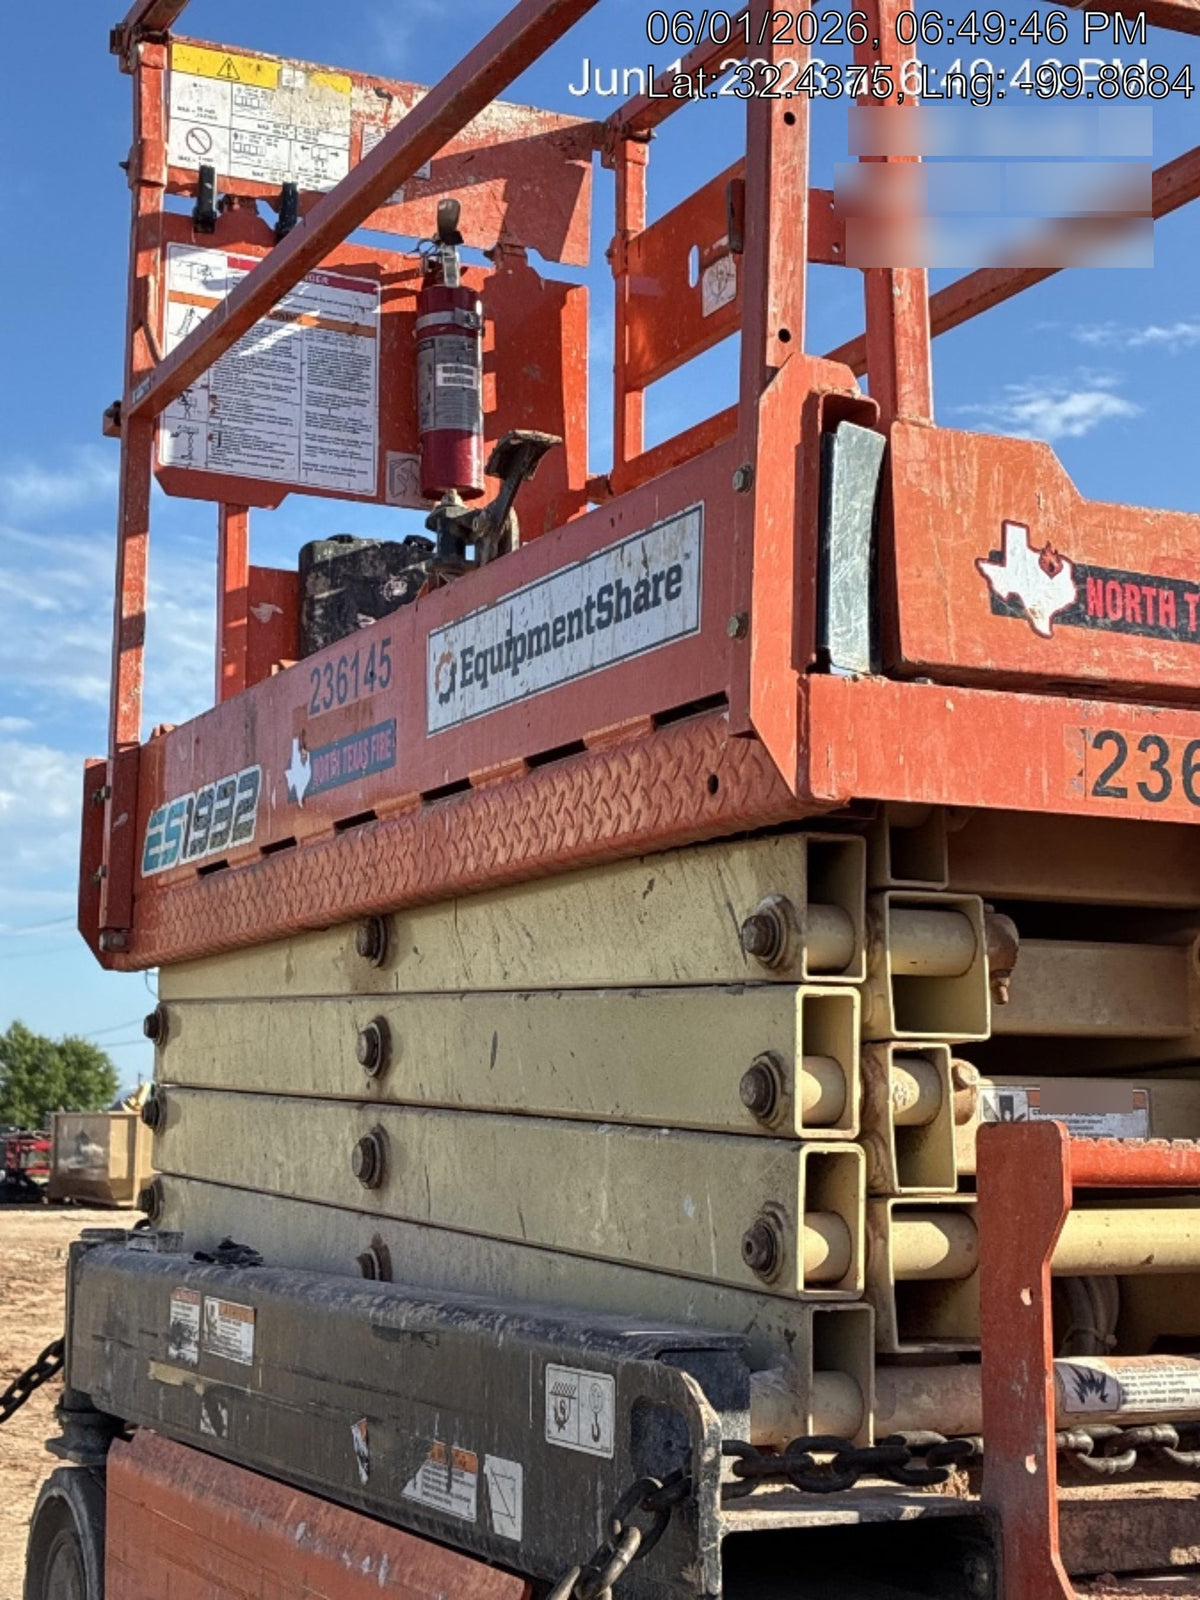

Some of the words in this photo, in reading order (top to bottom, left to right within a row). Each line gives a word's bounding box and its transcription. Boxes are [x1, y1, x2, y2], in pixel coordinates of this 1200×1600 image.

[460, 563, 682, 690] EquipmentShare
[1086, 577, 1177, 629] NORTH
[309, 637, 392, 716] 236145
[142, 766, 261, 875] ES1932
